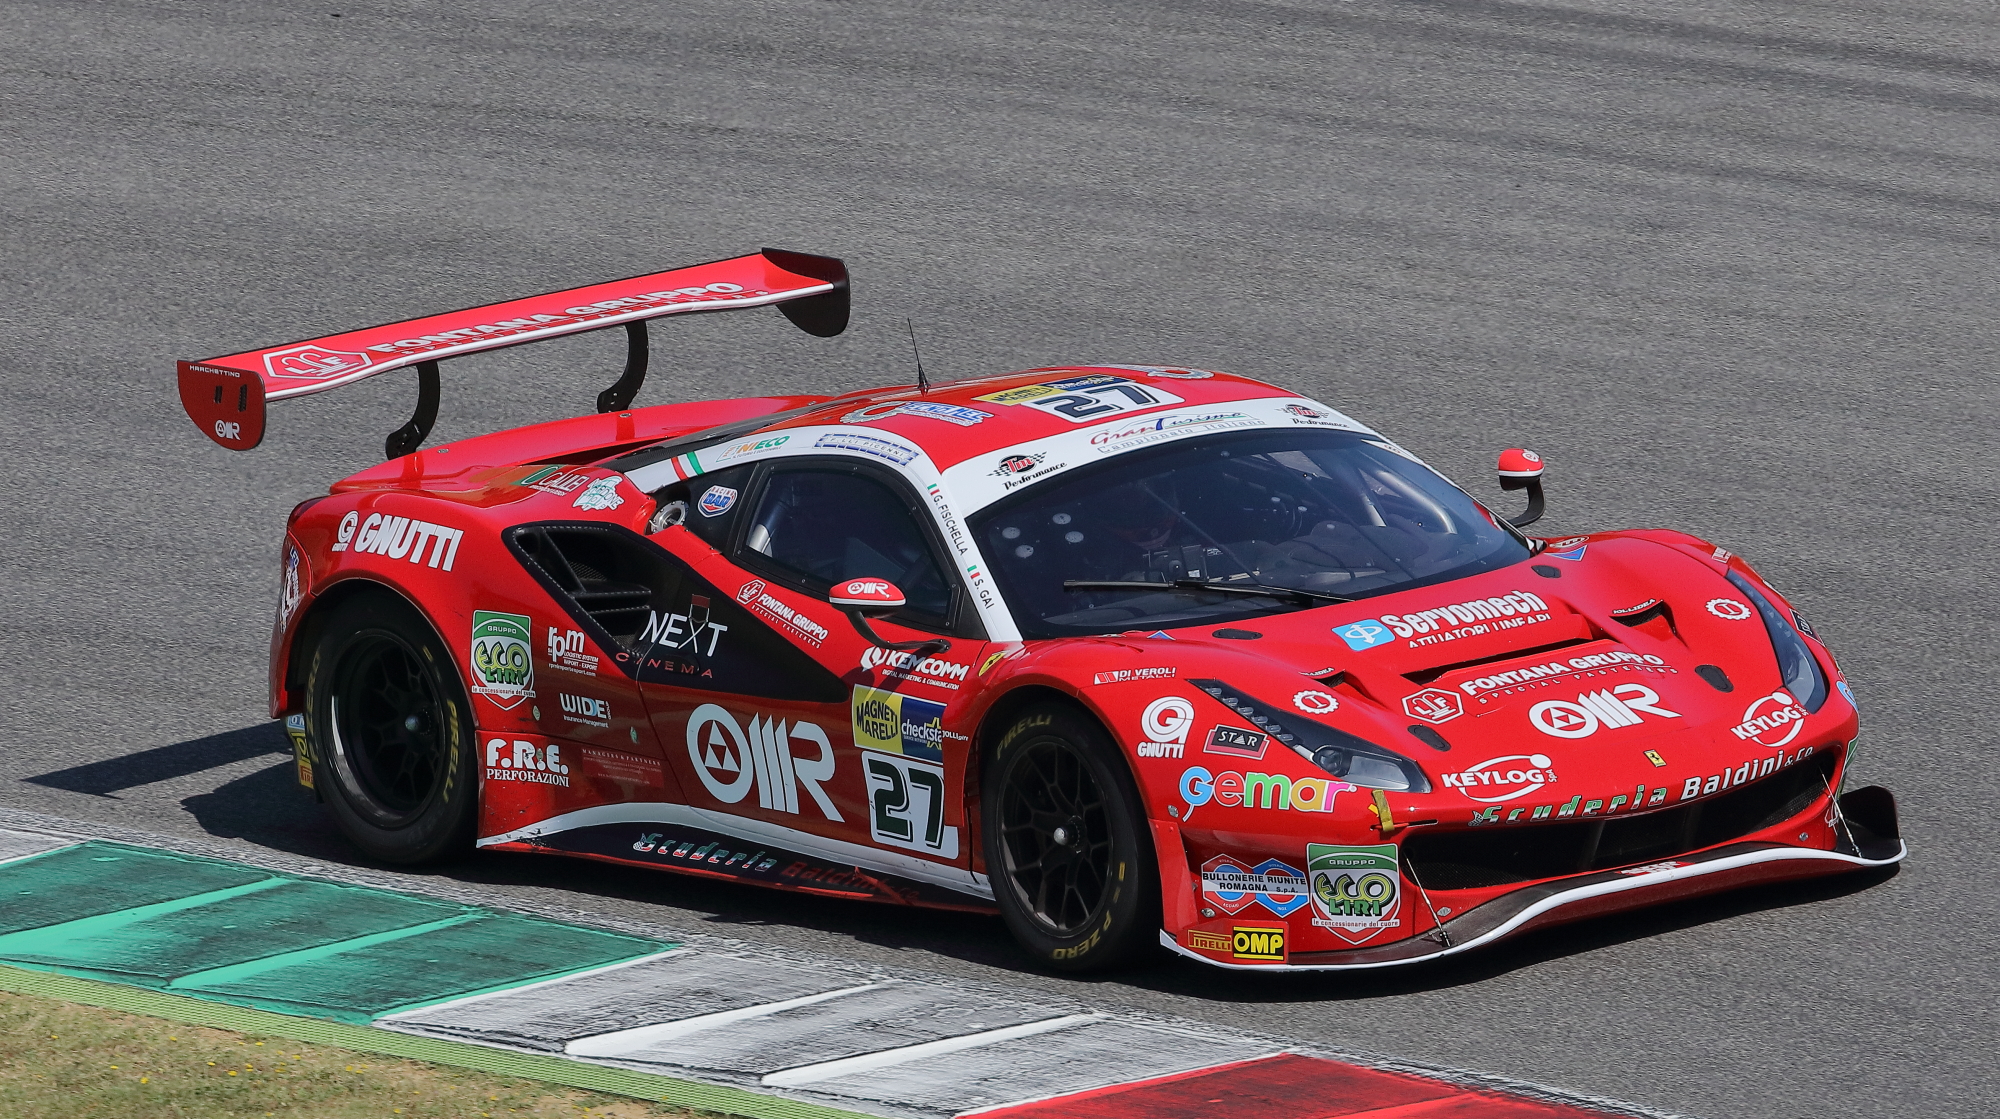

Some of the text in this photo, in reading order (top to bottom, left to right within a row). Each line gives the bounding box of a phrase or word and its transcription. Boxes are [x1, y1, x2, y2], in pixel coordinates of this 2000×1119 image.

[367, 282, 743, 353] FONTANA GRUPPO
[1031, 384, 1161, 419] 27
[1098, 419, 1266, 454] Campionato Italiano
[1002, 462, 1067, 491] Performance
[354, 512, 464, 572] GNUTTI
[937, 503, 969, 556] FISICHELLA
[979, 589, 995, 609] GAI
[757, 593, 829, 640] FONTANA GRUPPO
[1380, 589, 1549, 638] Servomech
[487, 625, 517, 634] GRUPPO
[639, 609, 728, 657] NEXT
[474, 640, 530, 675] ECO
[547, 626, 585, 662] rpm
[485, 667, 525, 686] LIRI
[615, 652, 713, 679] CINEMA
[1119, 667, 1176, 678] DI VEROLI
[1459, 651, 1665, 695] FONTANA GRUPPO
[1479, 678, 1560, 704] SPECIAL
[559, 692, 607, 719] WIDE
[856, 699, 898, 726] MAGNETI
[857, 718, 899, 741] MARELLI
[901, 718, 943, 743] checksta
[1730, 705, 1802, 740] KEYLOG
[996, 713, 1052, 761] PIRELLI
[1137, 741, 1184, 759] GNUTTI
[1217, 731, 1258, 747] STAR
[486, 738, 569, 775] F.R.E.
[582, 748, 619, 759] MANAGERS
[626, 755, 661, 766] PARTNERS
[486, 768, 569, 787] PERFORAZIONI
[1441, 769, 1545, 788] KEYLOG
[1481, 785, 1668, 826] Scuderia
[1680, 750, 1785, 801] Baldini
[1784, 754, 1794, 768] &
[867, 758, 945, 850] 27
[1178, 766, 1352, 822] Gemar
[634, 832, 778, 873] Scuderia
[1202, 872, 1306, 885] BULLONERIE RIUNITE
[1219, 883, 1299, 894] ROMAGNA S.p.A.
[1314, 871, 1397, 906] ECO
[1329, 898, 1382, 917] LIRI
[1052, 909, 1112, 960] P ZERO
[1320, 919, 1368, 928] concessionarie
[1368, 920, 1380, 928] del
[1188, 929, 1232, 952] PIRELLI
[1234, 931, 1284, 954] OMP
